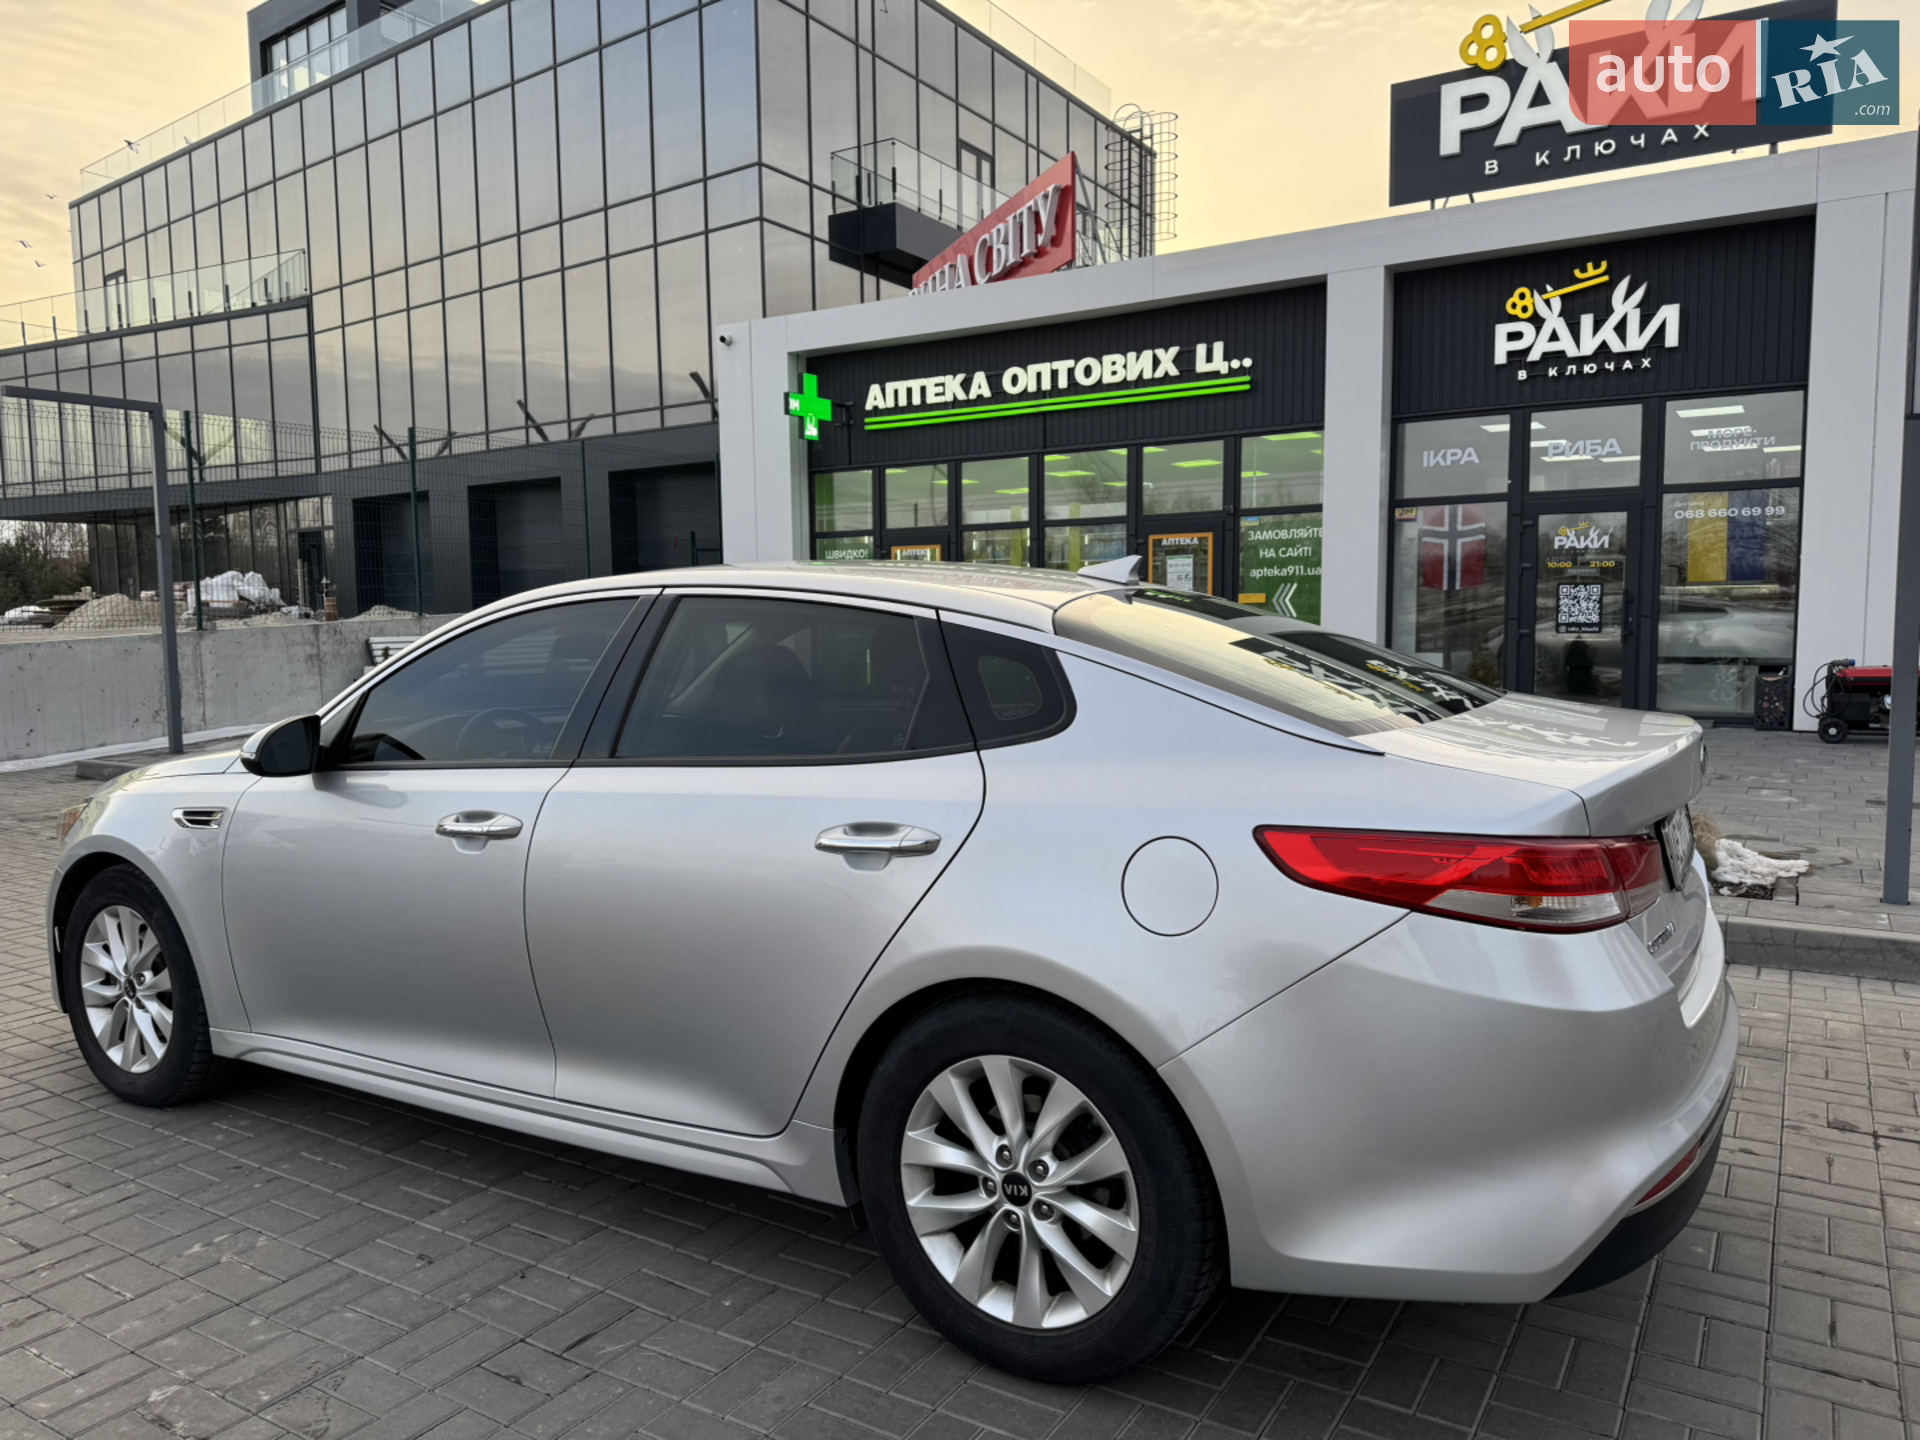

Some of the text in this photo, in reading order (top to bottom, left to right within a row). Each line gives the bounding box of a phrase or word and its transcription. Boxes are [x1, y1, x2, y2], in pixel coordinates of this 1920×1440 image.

[1484, 122, 1710, 175] В КЛЮЧАХ
[974, 183, 1063, 285] СВІТУ
[1494, 275, 1681, 365] РАКИ
[865, 341, 1253, 411] АПТЕКА ОПТОВИХ Ц..
[1517, 357, 1652, 380] В КЛЮЧАХ
[1547, 438, 1623, 459] РИБА
[1690, 436, 1776, 451] ПРОДУКТИ
[1422, 447, 1480, 468] ІКРА
[1674, 505, 1786, 520] 068 660 69 99
[1248, 526, 1324, 541] ЗАМОВЛЯЙТЕ
[1554, 526, 1610, 550] РАКИ
[1161, 538, 1200, 547] АПТЕКА
[825, 549, 869, 560] ШВИДКО!
[1259, 546, 1312, 558] НА САЙТІ
[1249, 565, 1322, 579] apteka911.ua
[1546, 560, 1616, 569] 10:00 21:00
[1004, 1183, 1029, 1197] KIA
